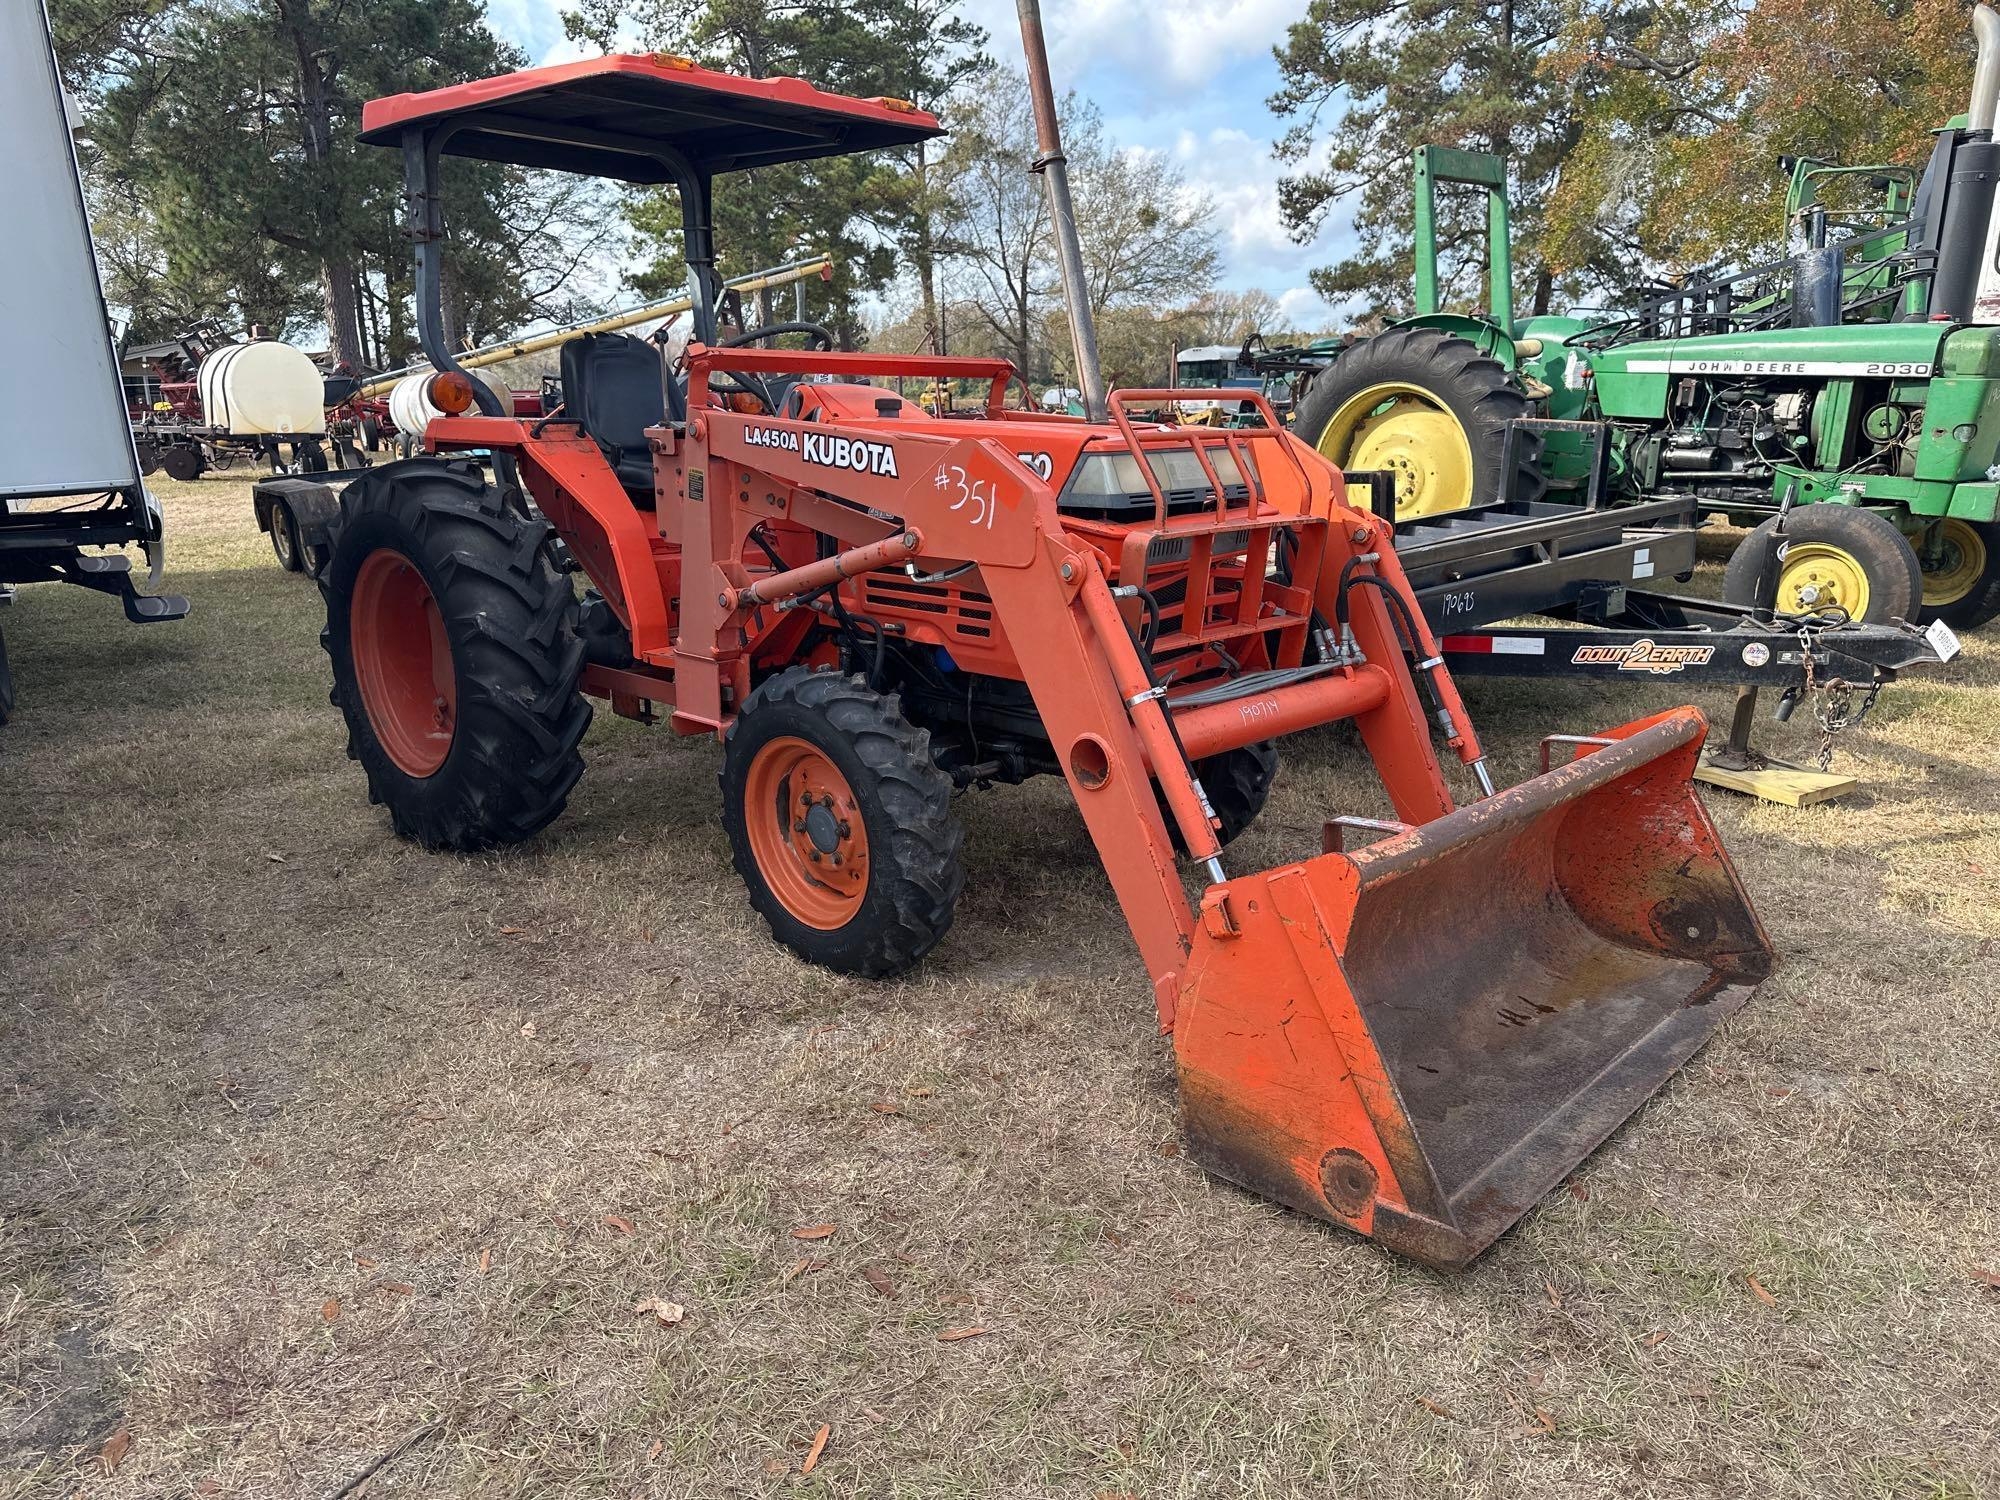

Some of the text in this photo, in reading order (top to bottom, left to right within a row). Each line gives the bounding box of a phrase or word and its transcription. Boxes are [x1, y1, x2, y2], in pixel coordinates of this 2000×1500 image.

[1743, 363, 1806, 373] DEERE
[1866, 364, 1929, 375] 2030
[744, 426, 899, 478] LA450A KUBOTA
[934, 463, 996, 530] #351
